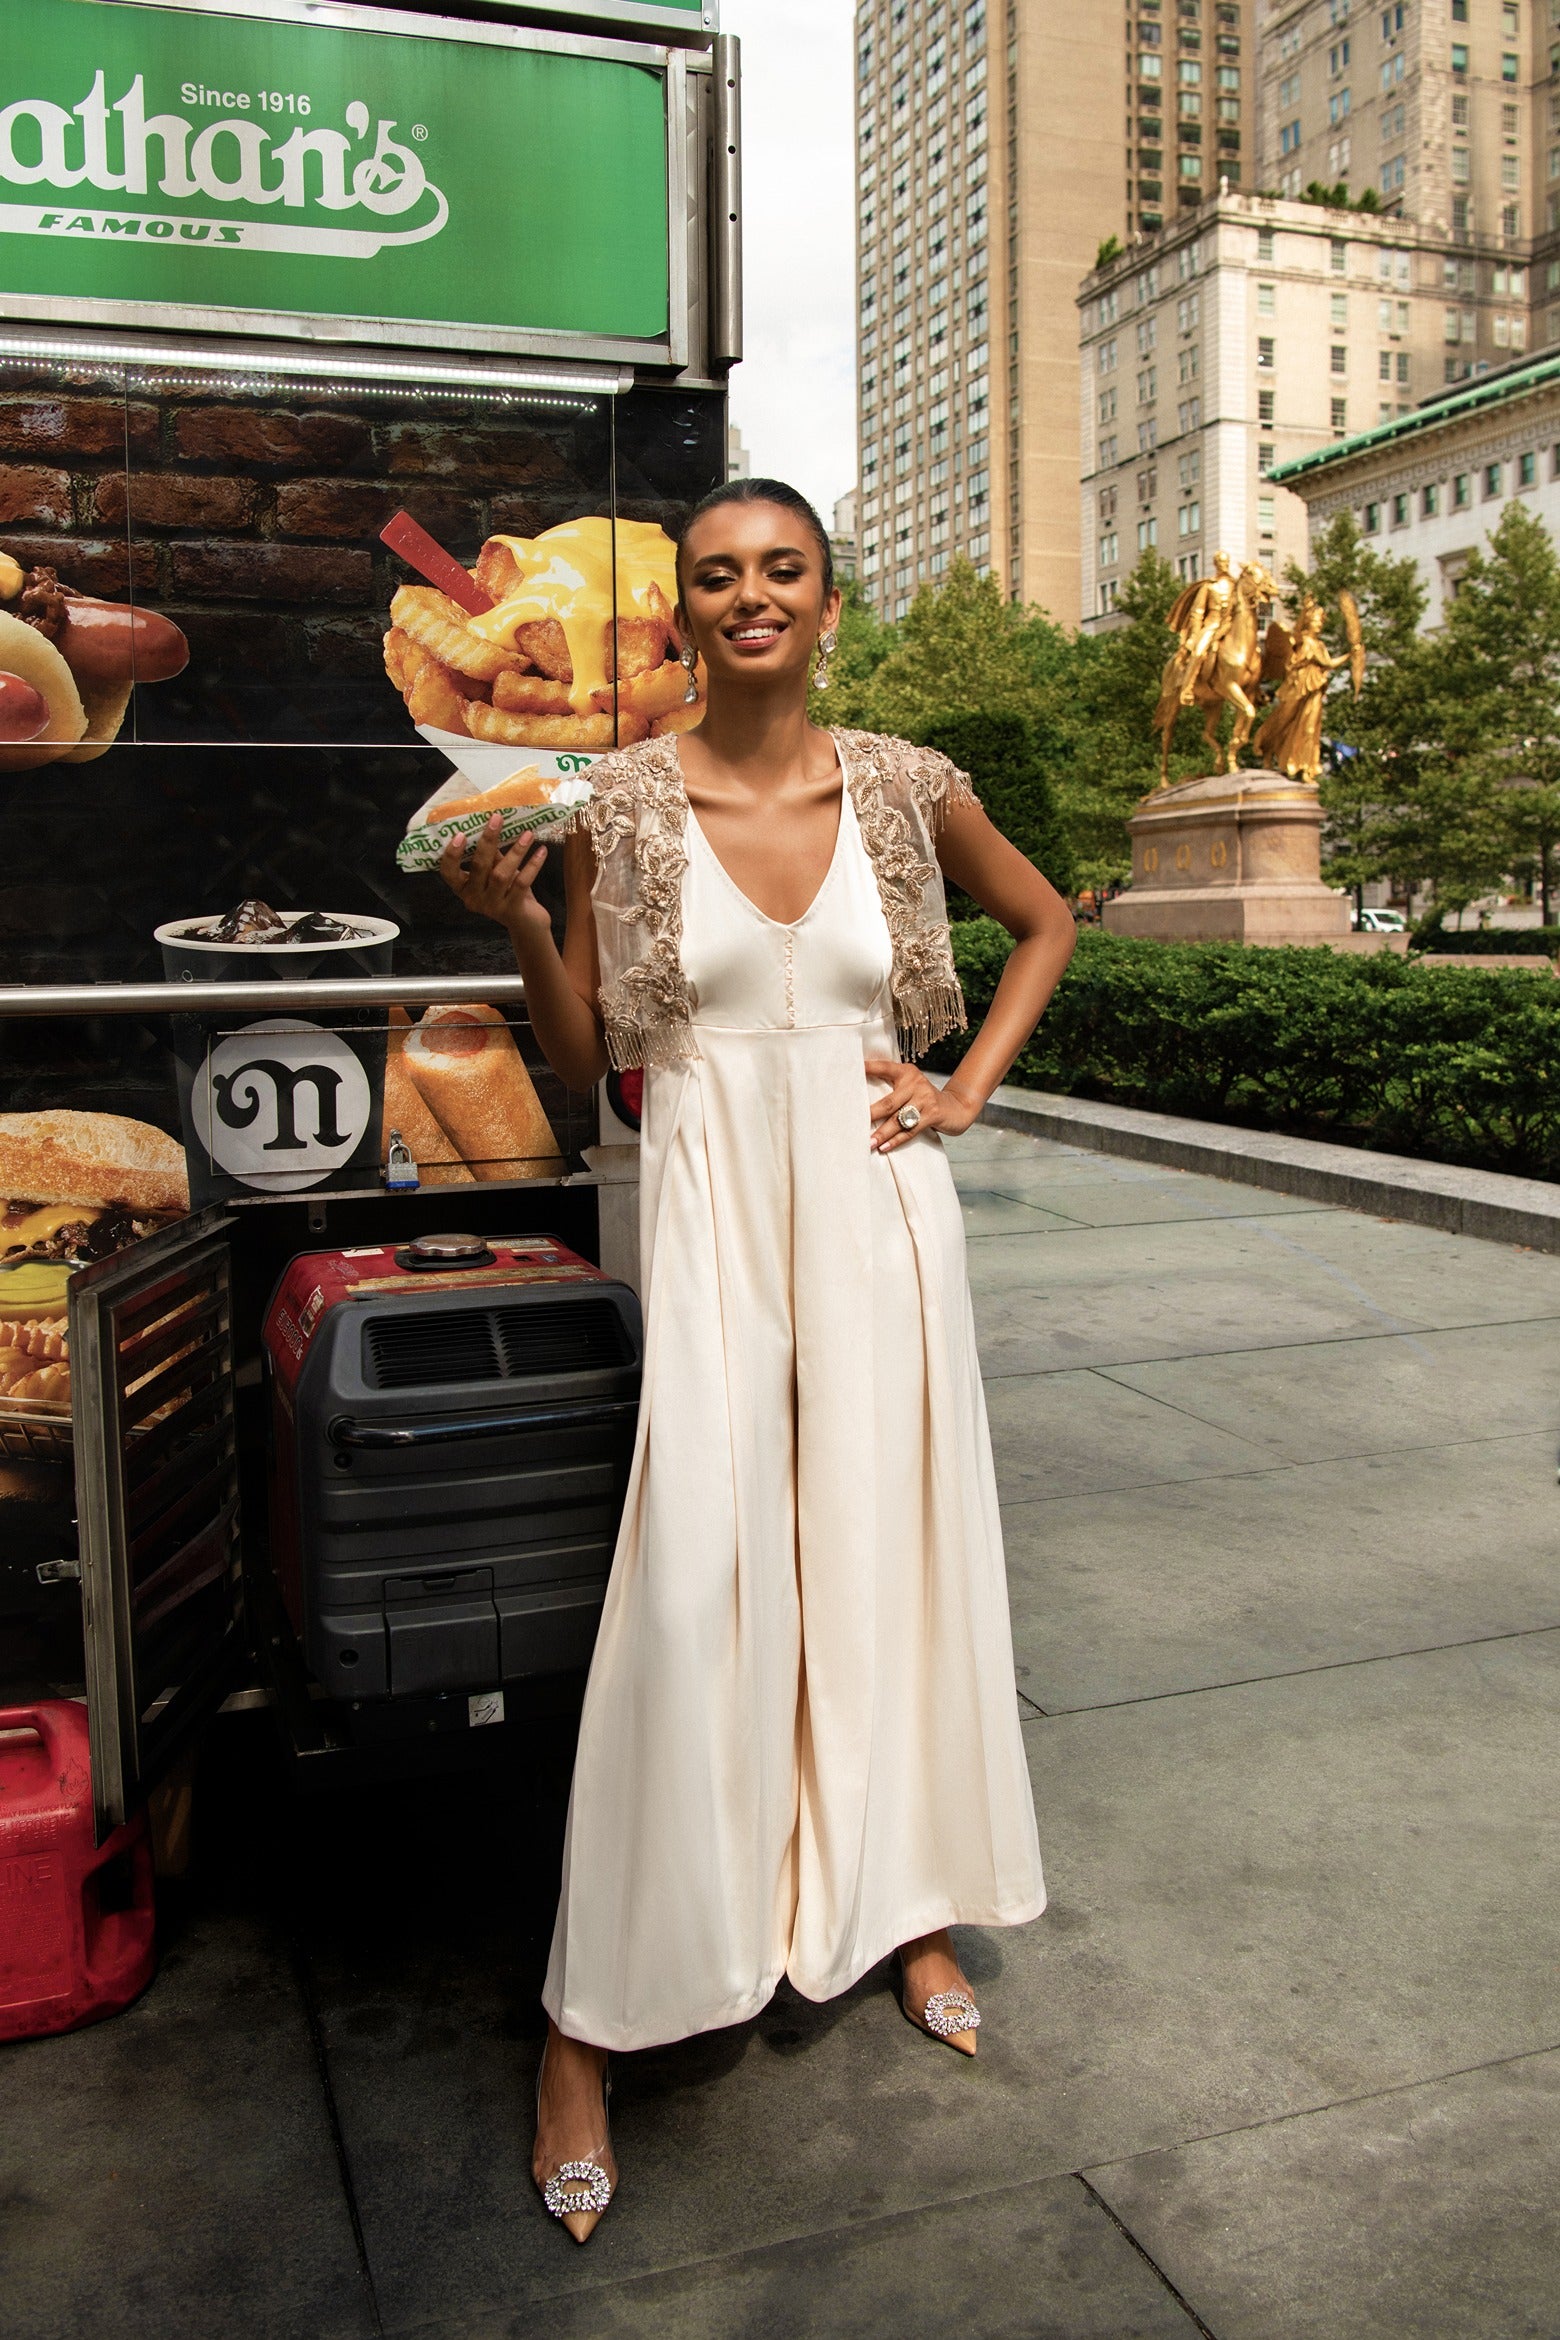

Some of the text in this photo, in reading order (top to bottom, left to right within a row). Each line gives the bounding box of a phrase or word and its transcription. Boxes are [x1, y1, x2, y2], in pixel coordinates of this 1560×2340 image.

[181, 83, 312, 115] Since 1916
[38, 214, 244, 243] FAMOUS
